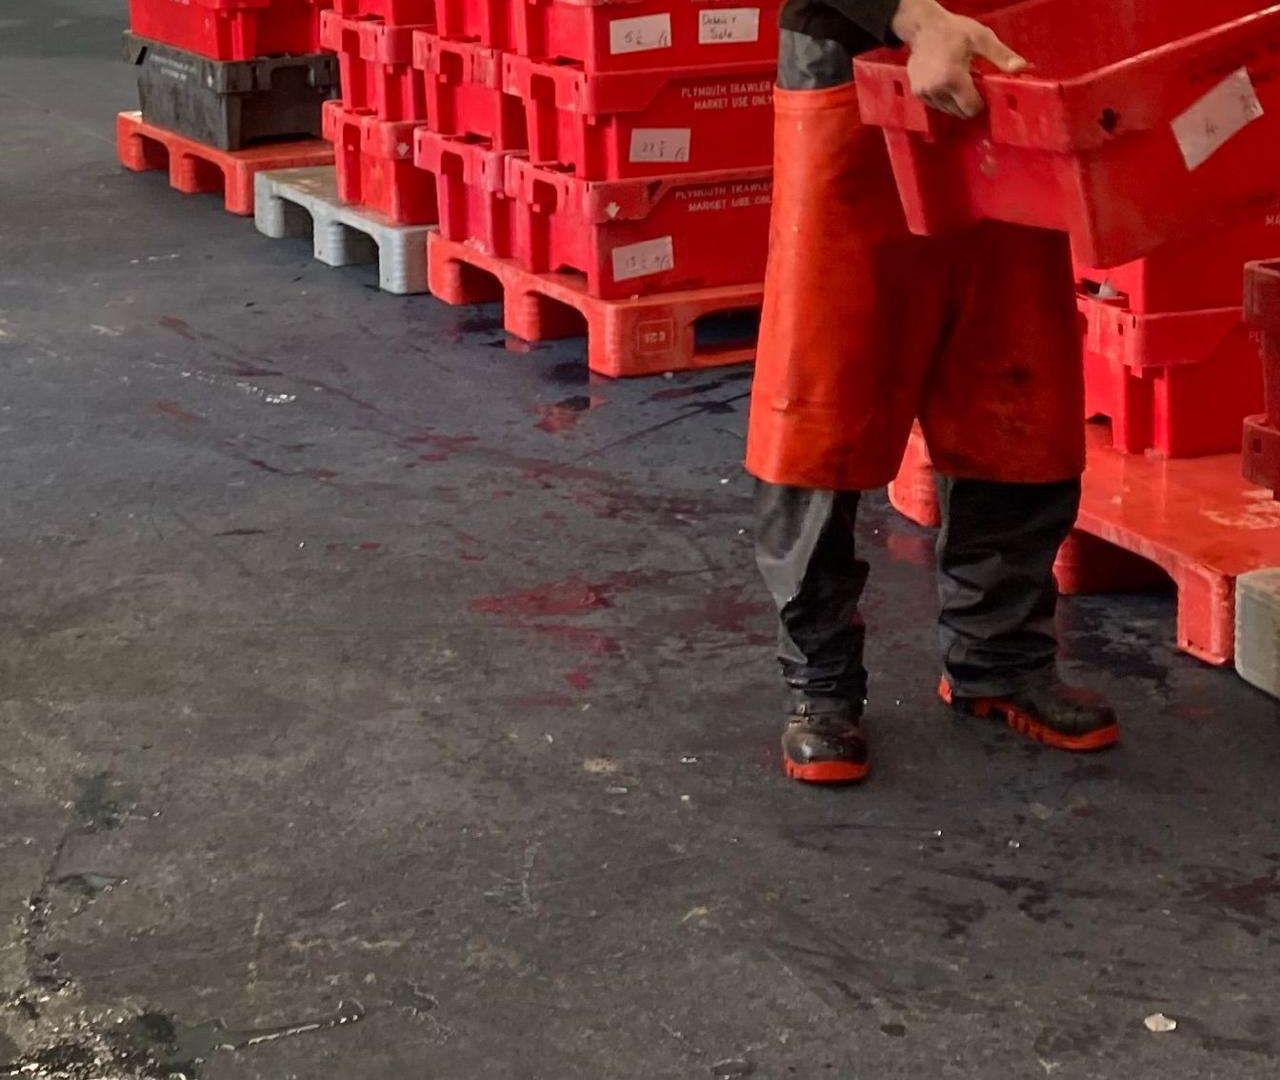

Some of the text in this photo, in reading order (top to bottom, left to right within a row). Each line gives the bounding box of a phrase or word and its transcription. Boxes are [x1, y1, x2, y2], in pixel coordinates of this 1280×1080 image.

[681, 81, 770, 98] PLYMOUTH TRAWLER
[694, 95, 774, 111] MARKET USE ONLY
[675, 183, 773, 199] PLYMOUTH TRAWLE
[688, 199, 727, 212] MARKET
[731, 197, 751, 208] USE
